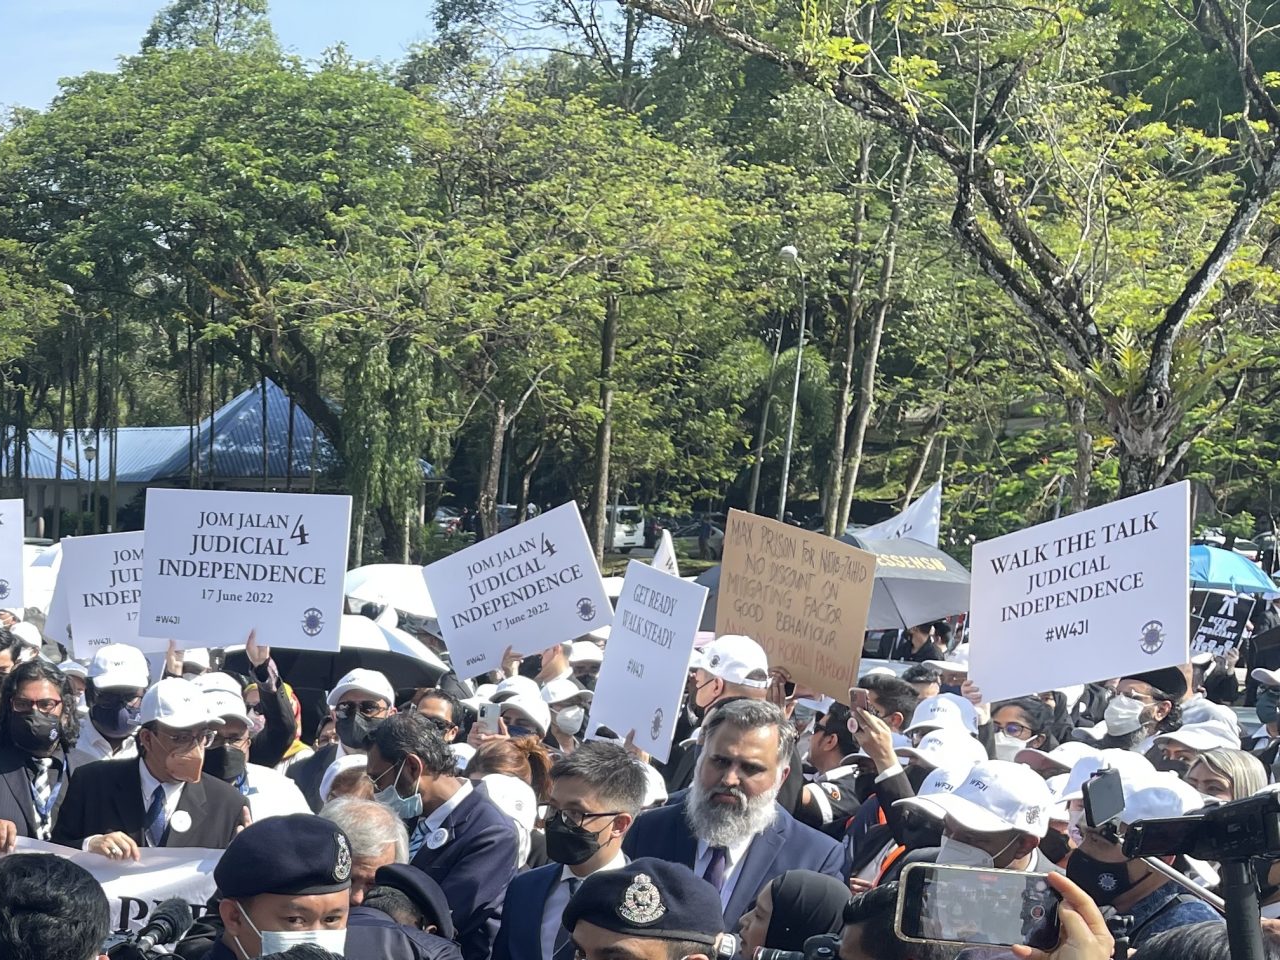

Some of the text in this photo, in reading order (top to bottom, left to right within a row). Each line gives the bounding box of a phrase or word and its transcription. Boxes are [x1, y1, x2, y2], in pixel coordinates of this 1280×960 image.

[189, 534, 289, 556] JUDICIAL
[198, 511, 310, 546] JOM JALAN 4
[730, 519, 753, 549] MAX
[990, 511, 1159, 576] WALK THE TALK
[113, 548, 144, 565] JOM
[158, 558, 326, 585] INDEPENDENCE
[467, 532, 557, 580] JOM JALAN 4
[468, 557, 546, 603] JUDICIAL
[745, 553, 839, 601] NO DISCOUNT ON
[1026, 555, 1111, 595] JUDICIAL
[201, 588, 273, 604] 17 June 2022
[451, 564, 583, 629] INDEPENDENCE
[633, 583, 678, 617] GET READY
[726, 571, 842, 626] MITIGATING FACTOR
[1000, 571, 1144, 622] INDEPENDENCE
[155, 615, 181, 625] #W4JI
[492, 602, 550, 632] 17 June 2022
[622, 609, 676, 650] WALK STEADY
[733, 599, 837, 649] GOOD BEHAVIOUR
[1045, 619, 1089, 643] #W4JI
[88, 638, 111, 646] #W4JI
[934, 781, 954, 792] WFJI
[970, 778, 989, 792] WFJI
